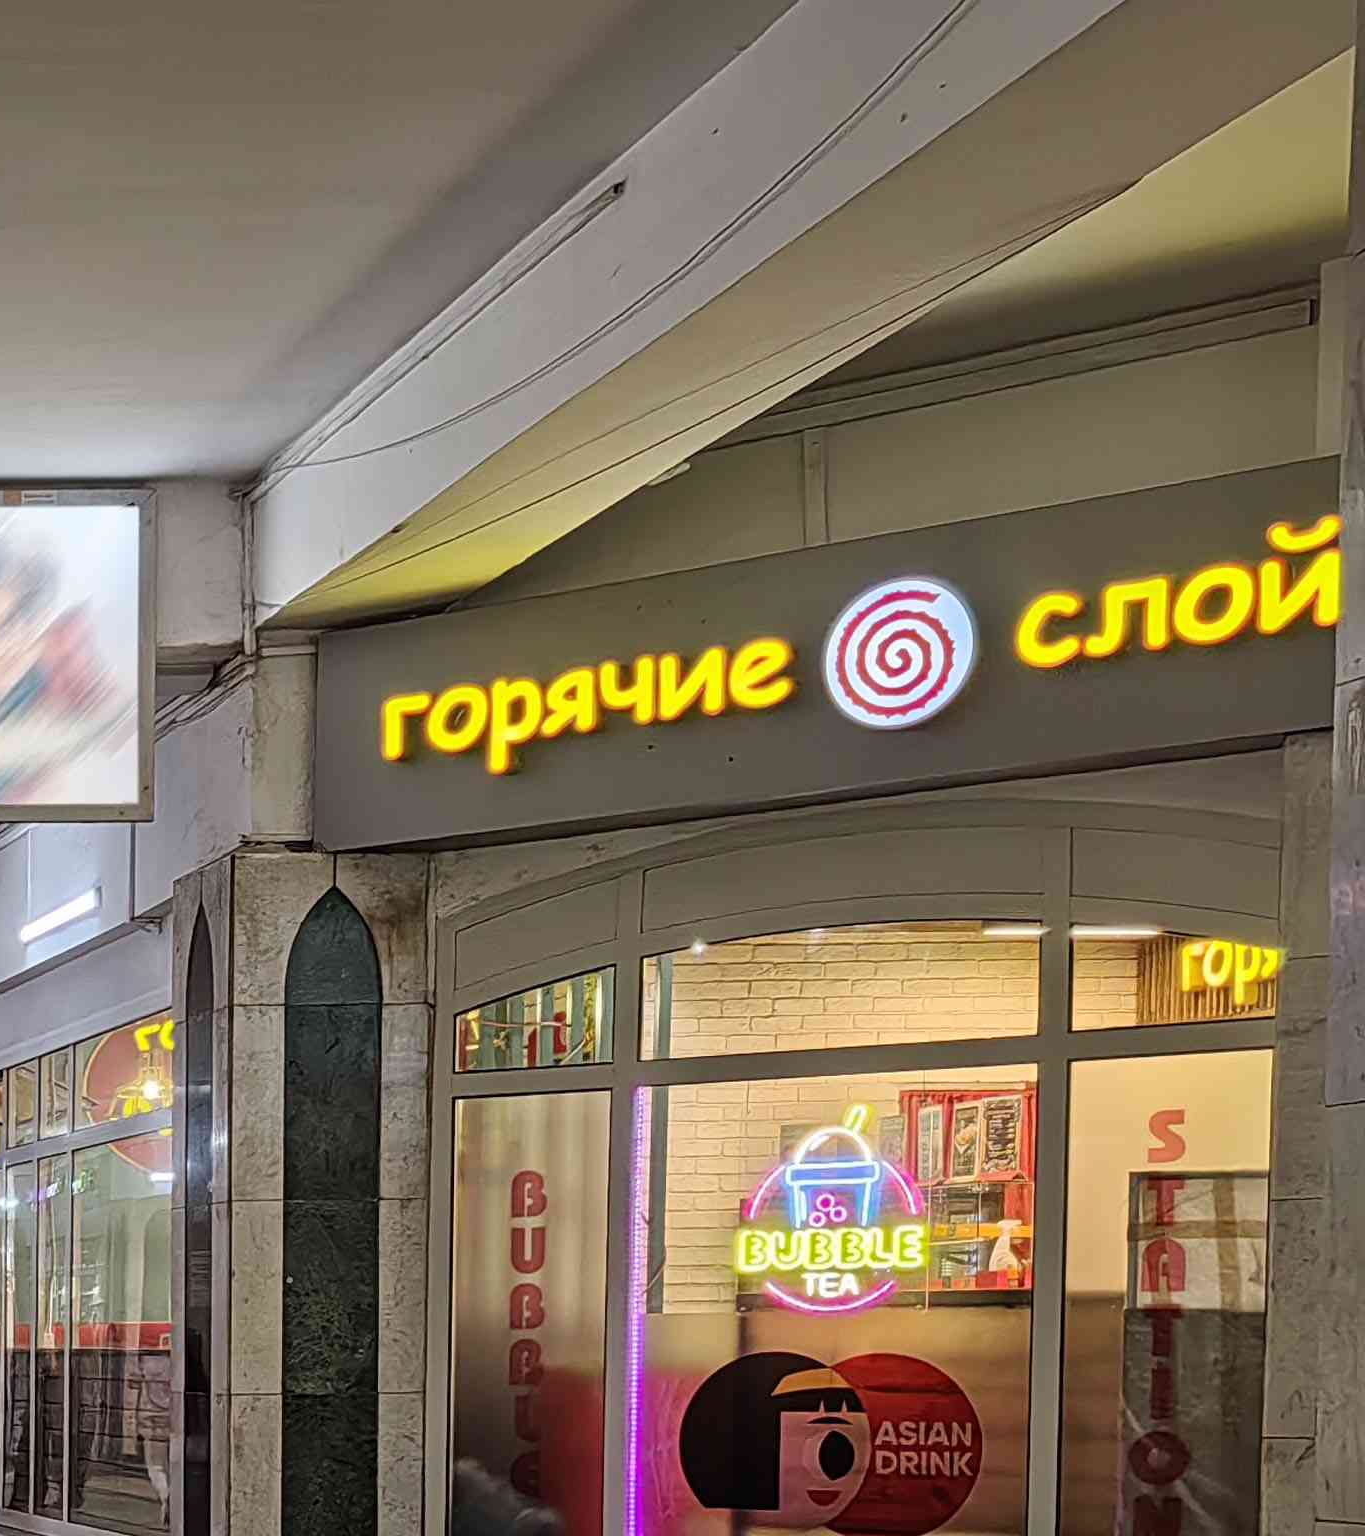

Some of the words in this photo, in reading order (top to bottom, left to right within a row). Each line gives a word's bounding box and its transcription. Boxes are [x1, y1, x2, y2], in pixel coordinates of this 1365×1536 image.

[380, 635, 795, 774] горячие
[1013, 514, 1343, 669] слой
[737, 1225, 926, 1273] BUBBLE
[801, 1272, 860, 1298] TEA
[509, 1170, 548, 1497] BUBBLE
[874, 1420, 972, 1446] ASIAN
[875, 1450, 973, 1476] DRINK
